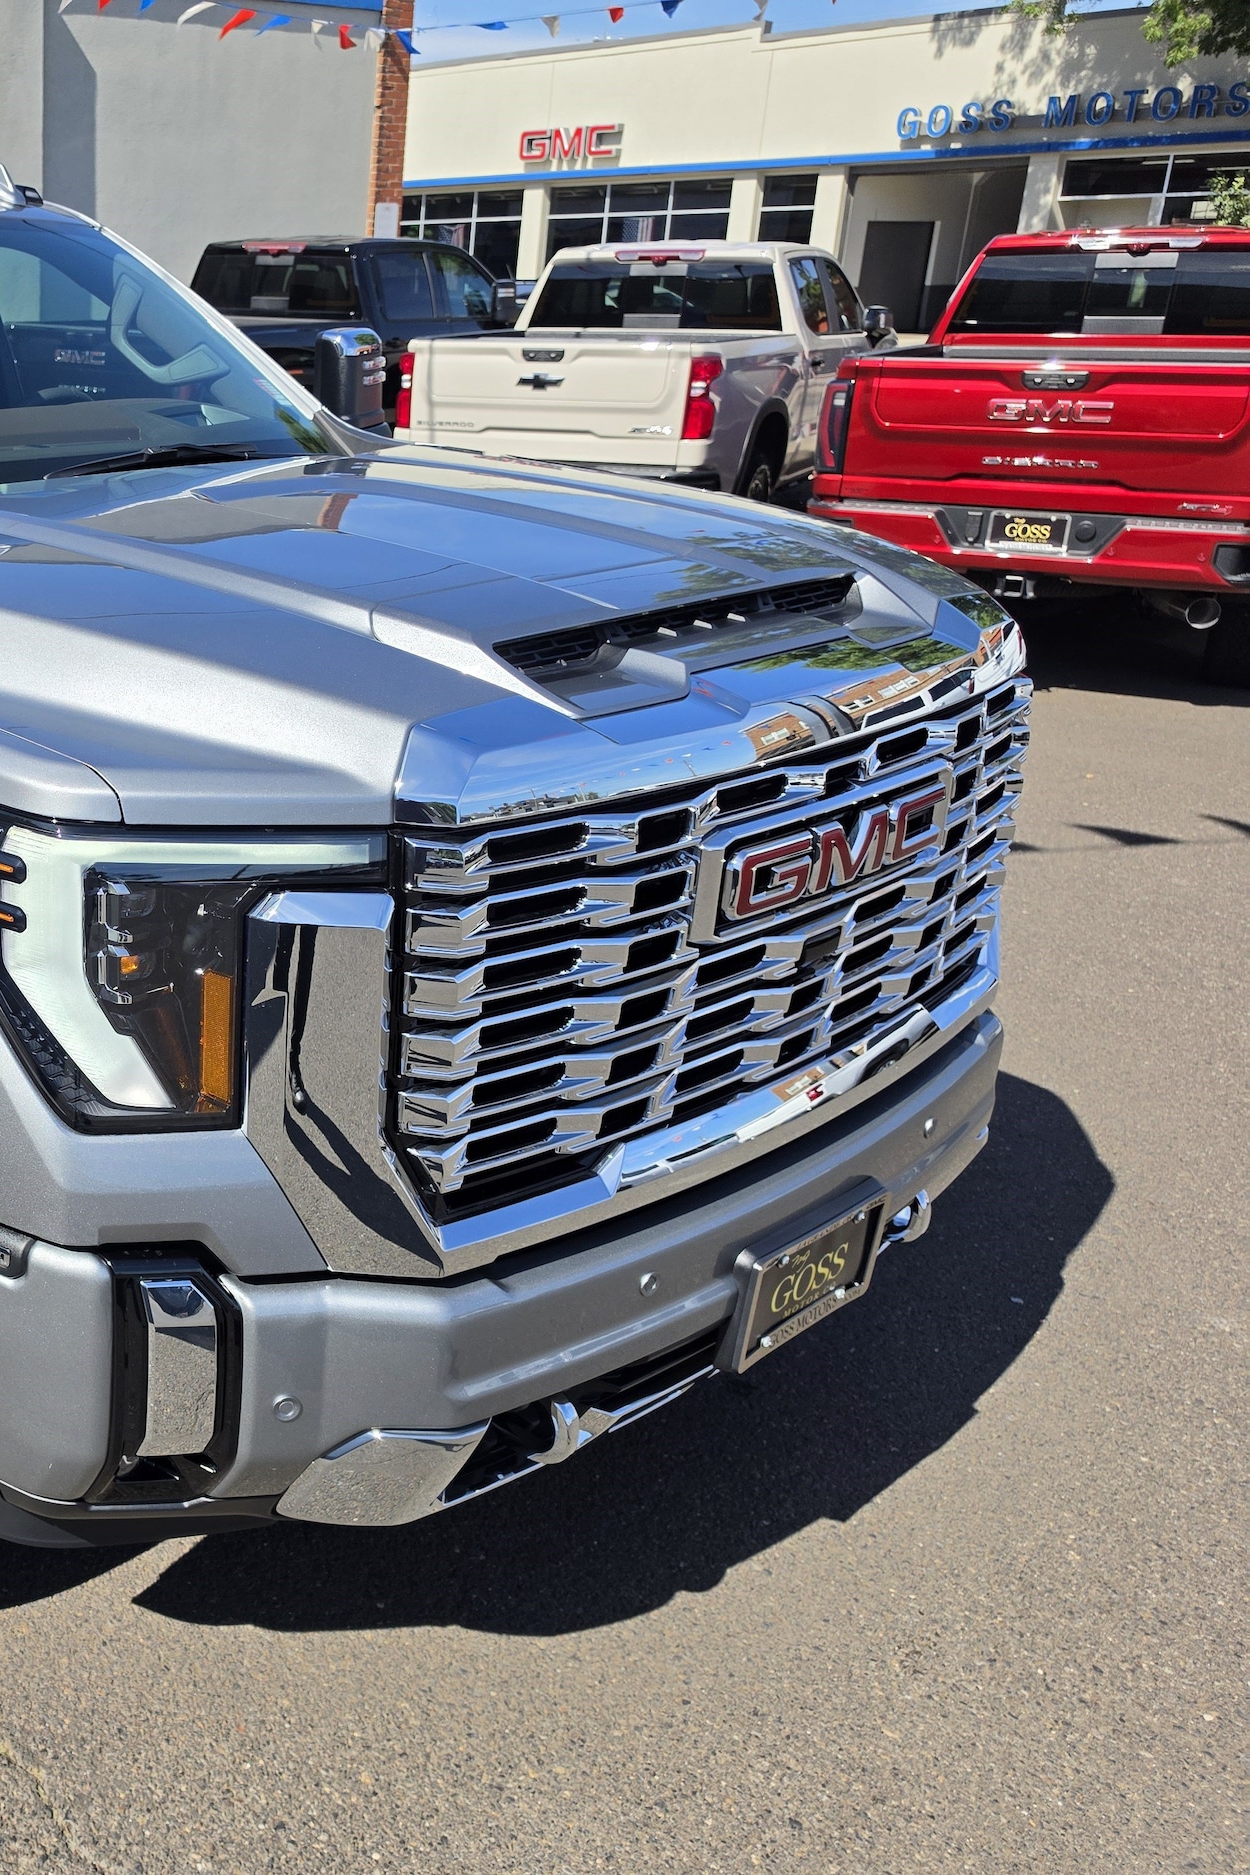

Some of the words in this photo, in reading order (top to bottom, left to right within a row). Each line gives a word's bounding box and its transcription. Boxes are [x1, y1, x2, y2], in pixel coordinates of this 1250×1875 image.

[896, 99, 1014, 140] GOSS
[1042, 82, 1250, 128] MOTORS
[519, 124, 620, 162] GMC
[986, 398, 1115, 424] GMC
[1004, 522, 1052, 540] GOSS
[727, 782, 947, 922] GMC
[770, 1241, 849, 1313] GOSS
[783, 1291, 820, 1319] MOTOR
